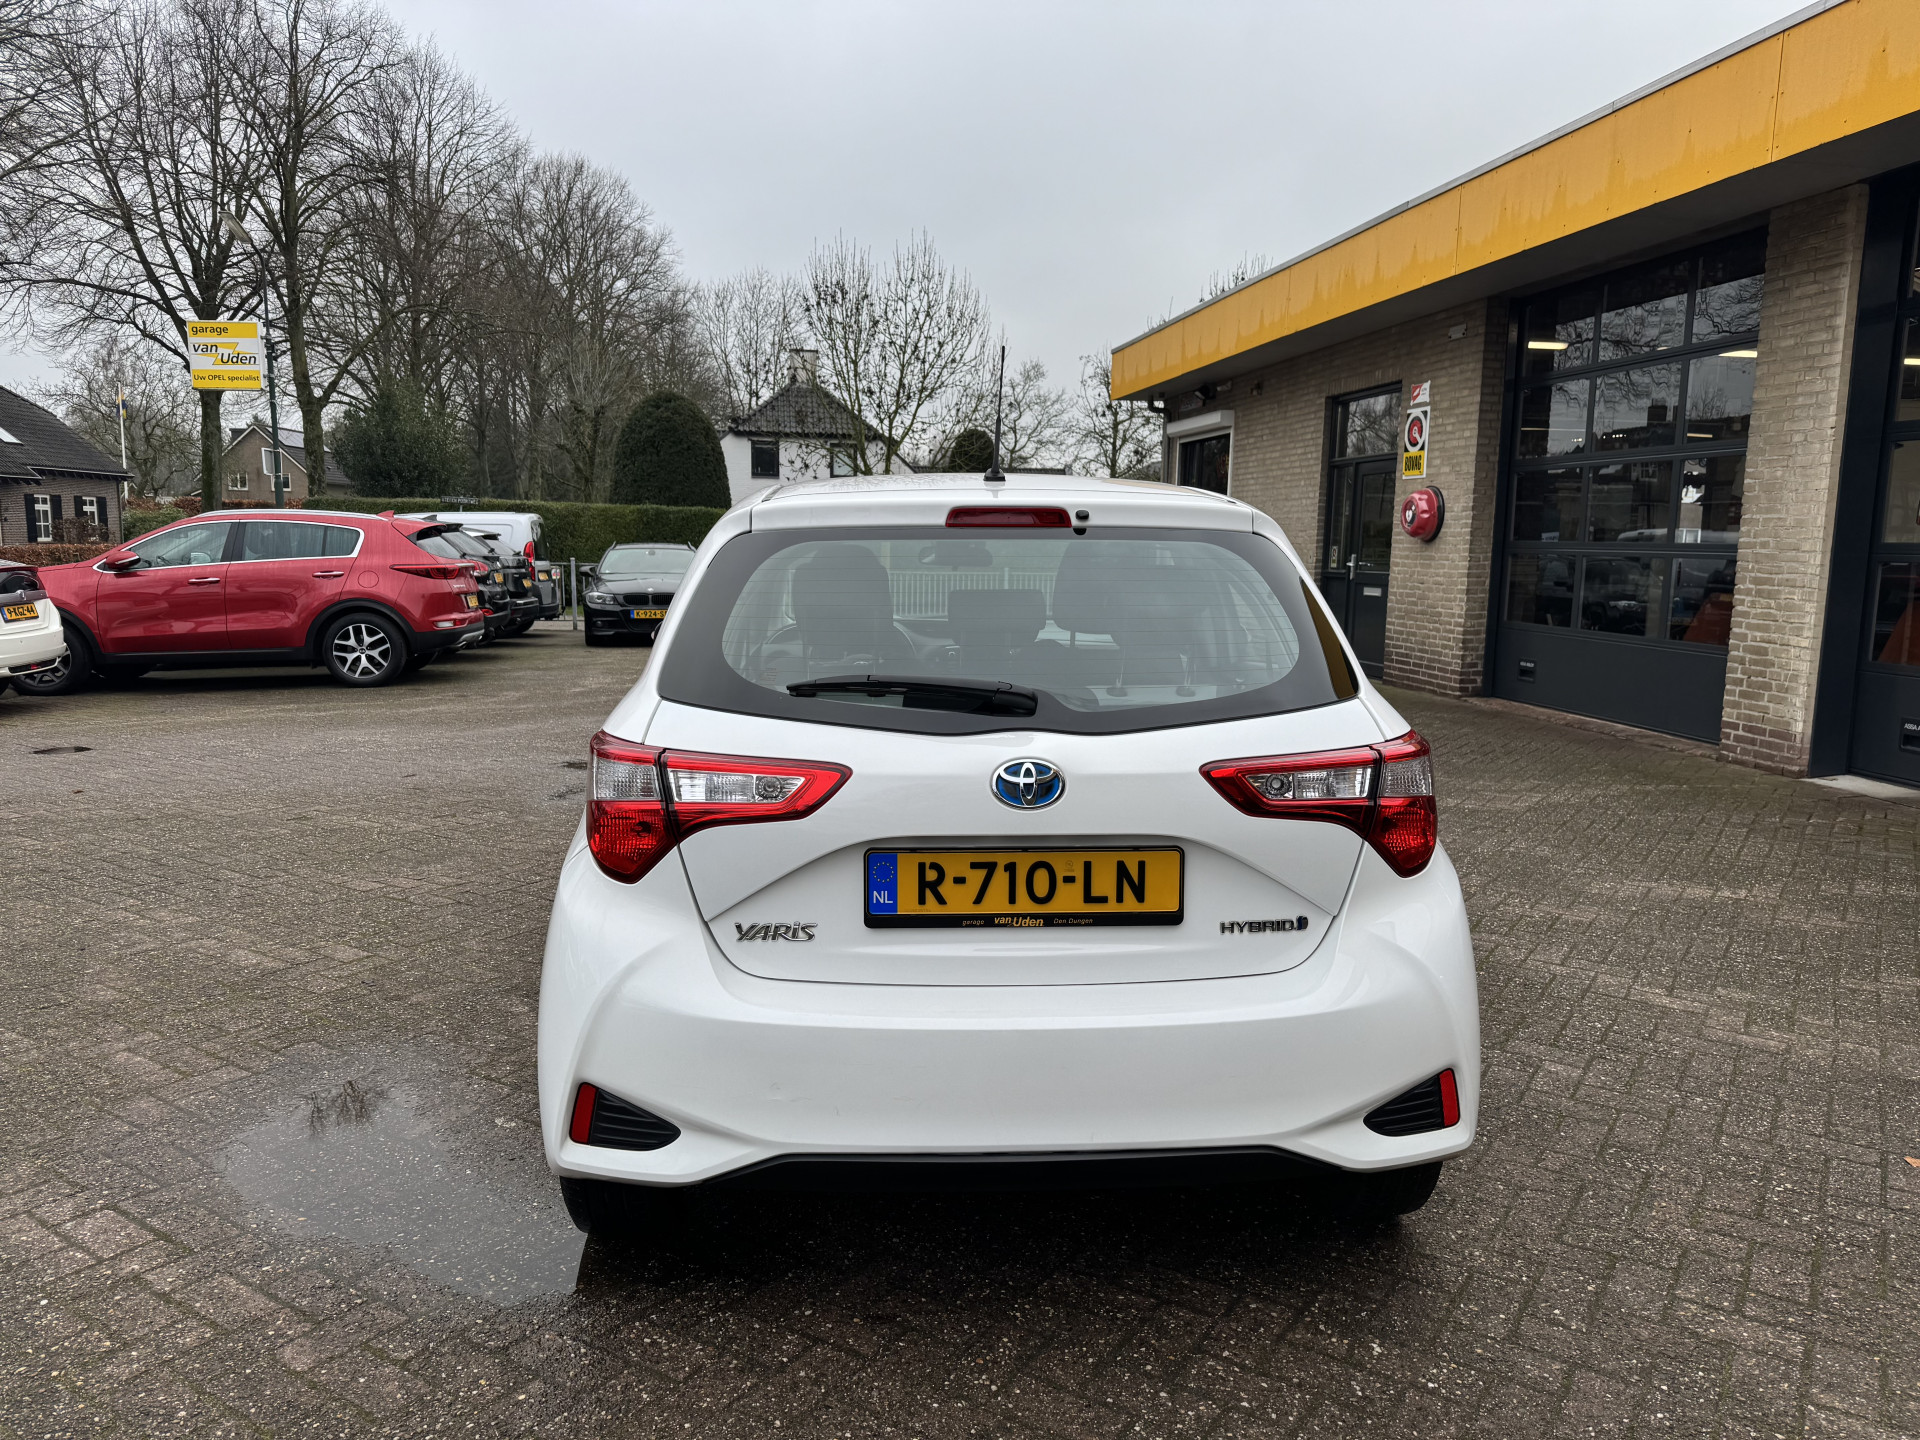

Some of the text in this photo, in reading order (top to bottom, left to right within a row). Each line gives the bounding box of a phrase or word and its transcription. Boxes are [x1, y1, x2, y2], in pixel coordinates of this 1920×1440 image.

[191, 326, 229, 335] garage
[193, 344, 218, 353] van
[220, 352, 257, 364] Uden
[227, 374, 260, 382] specialist
[1404, 454, 1422, 472] BOVAG
[917, 860, 1146, 905] R-710-LN
[873, 890, 893, 904] NL
[994, 916, 1012, 924] van
[1013, 916, 1044, 927] Uden
[1219, 919, 1295, 934] HYBRID
